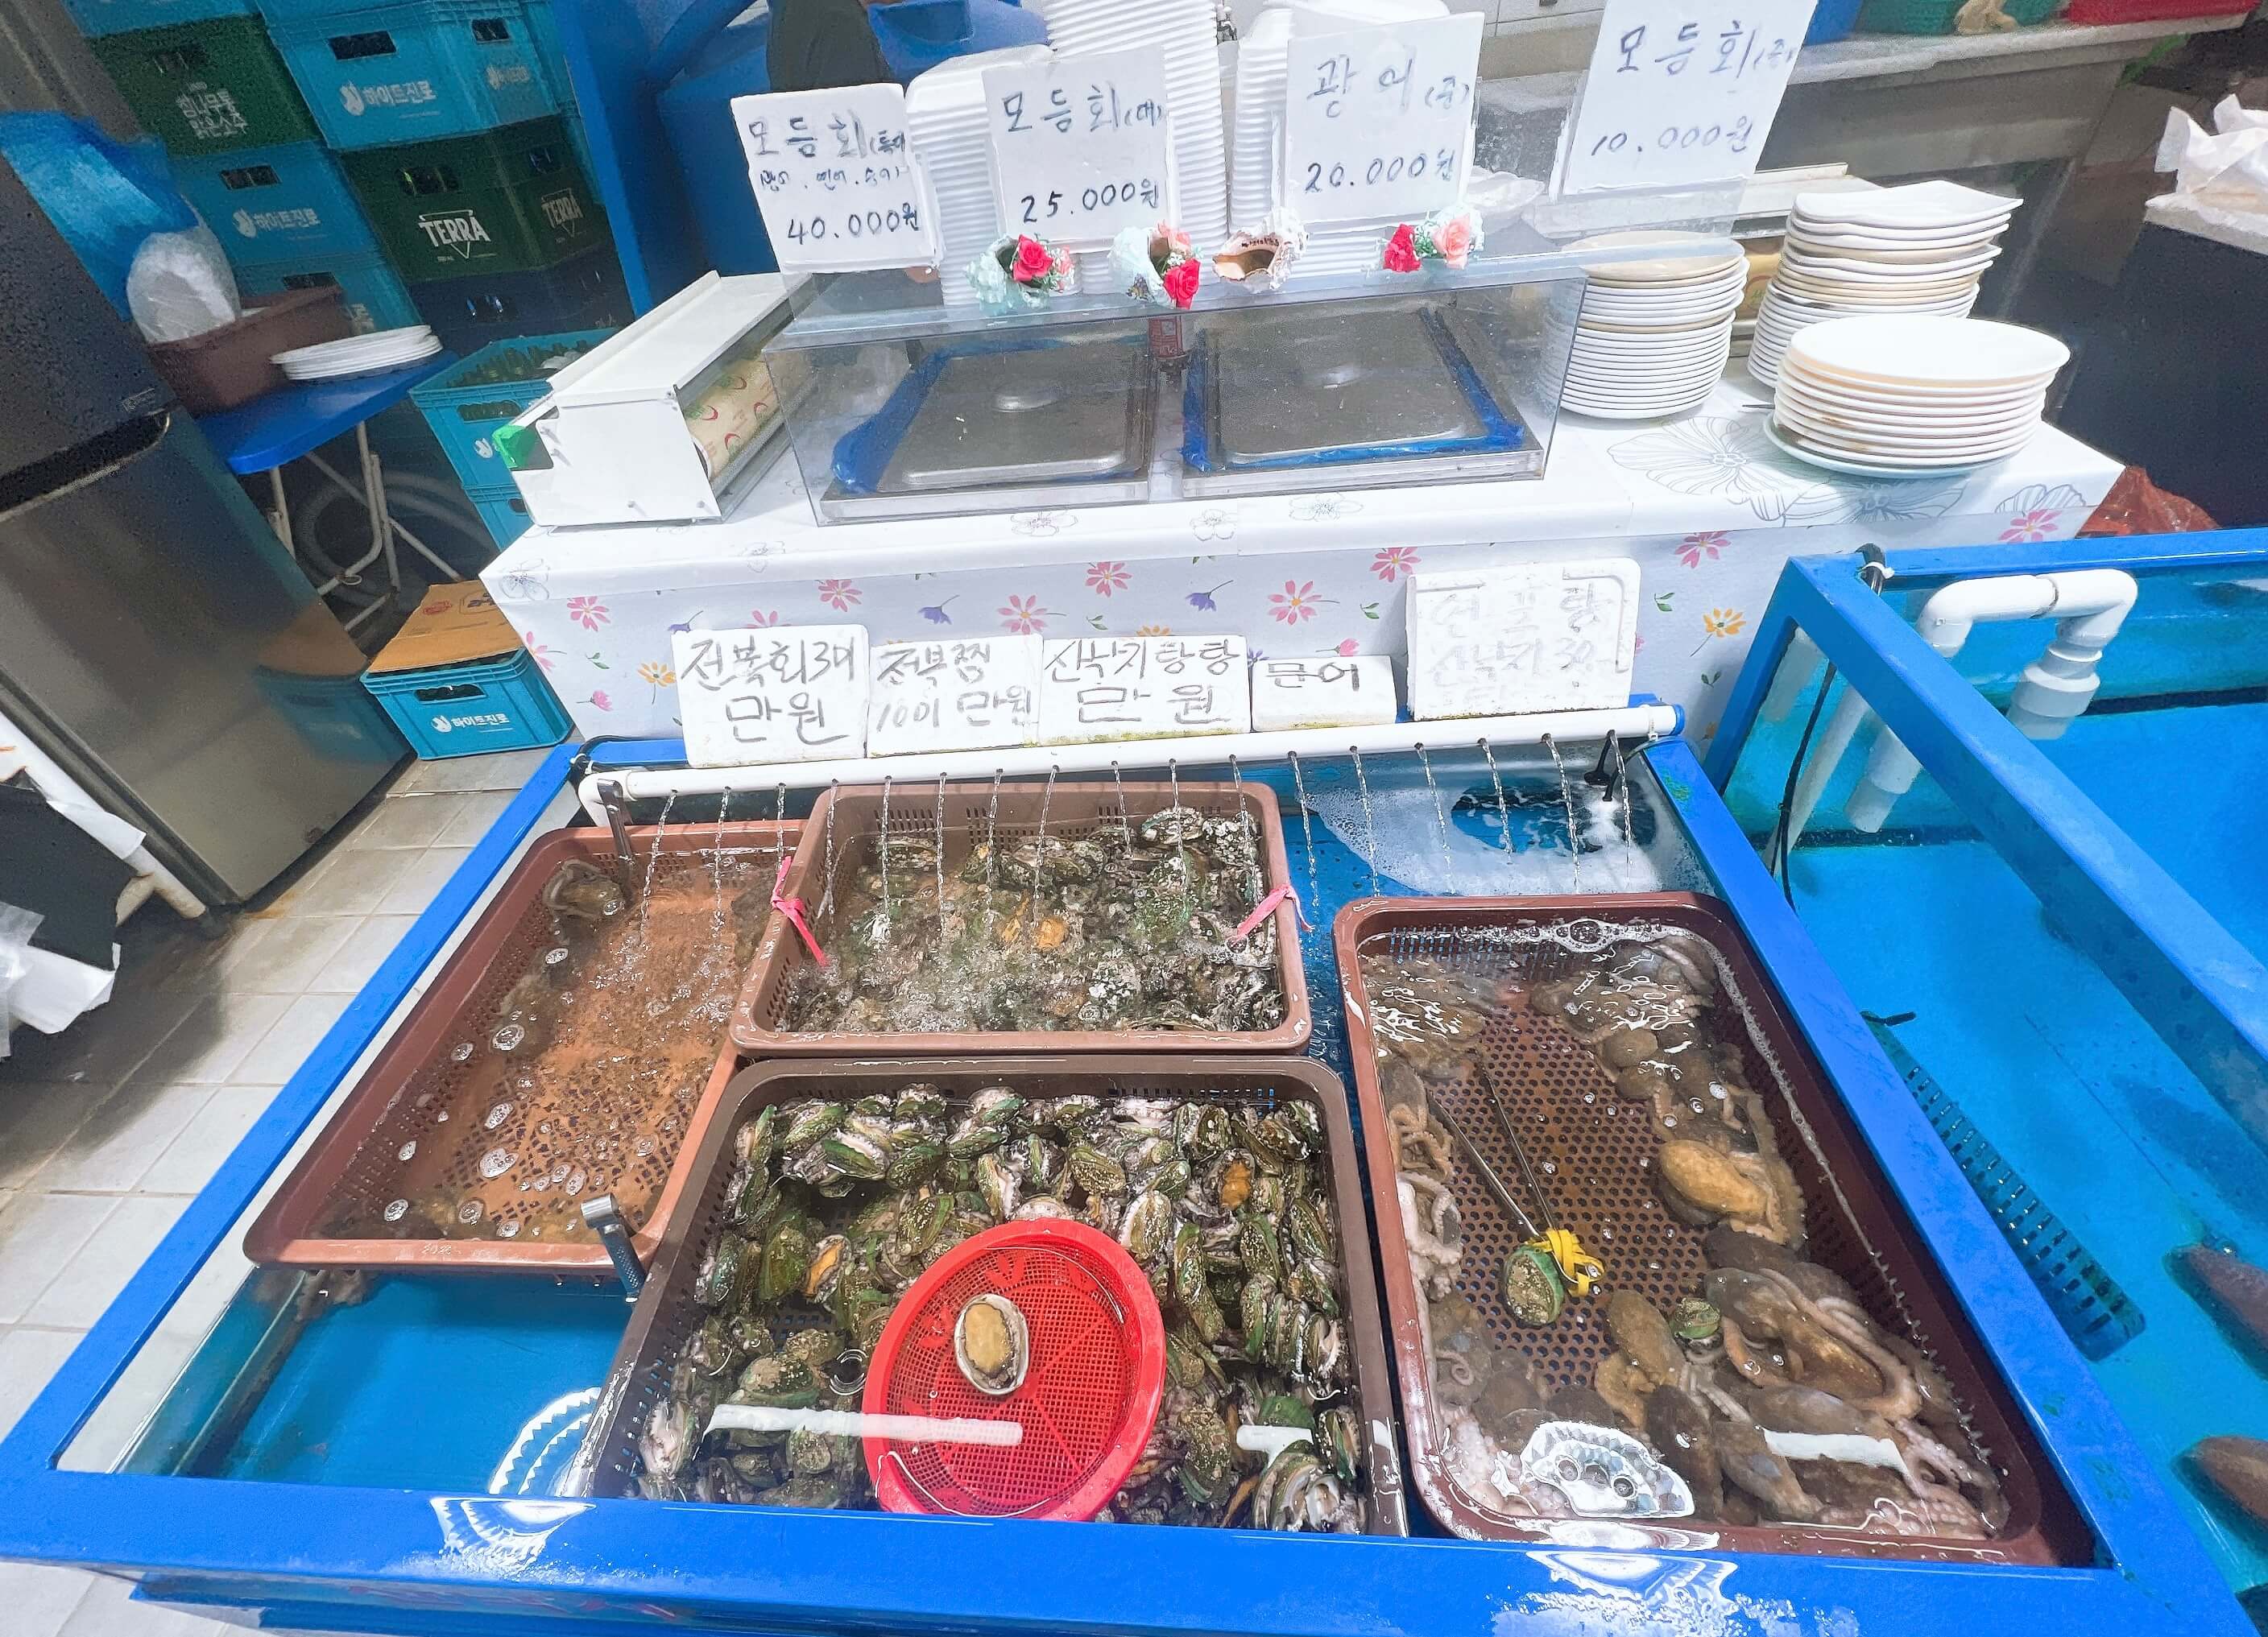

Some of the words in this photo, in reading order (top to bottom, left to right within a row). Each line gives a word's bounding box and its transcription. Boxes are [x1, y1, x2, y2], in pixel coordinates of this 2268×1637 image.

[362, 80, 437, 106] 하이트진로
[541, 196, 584, 229] TERRA
[418, 216, 491, 247] TERRA
[1265, 662, 1360, 692] 문어
[451, 713, 510, 728] 하이트진로
